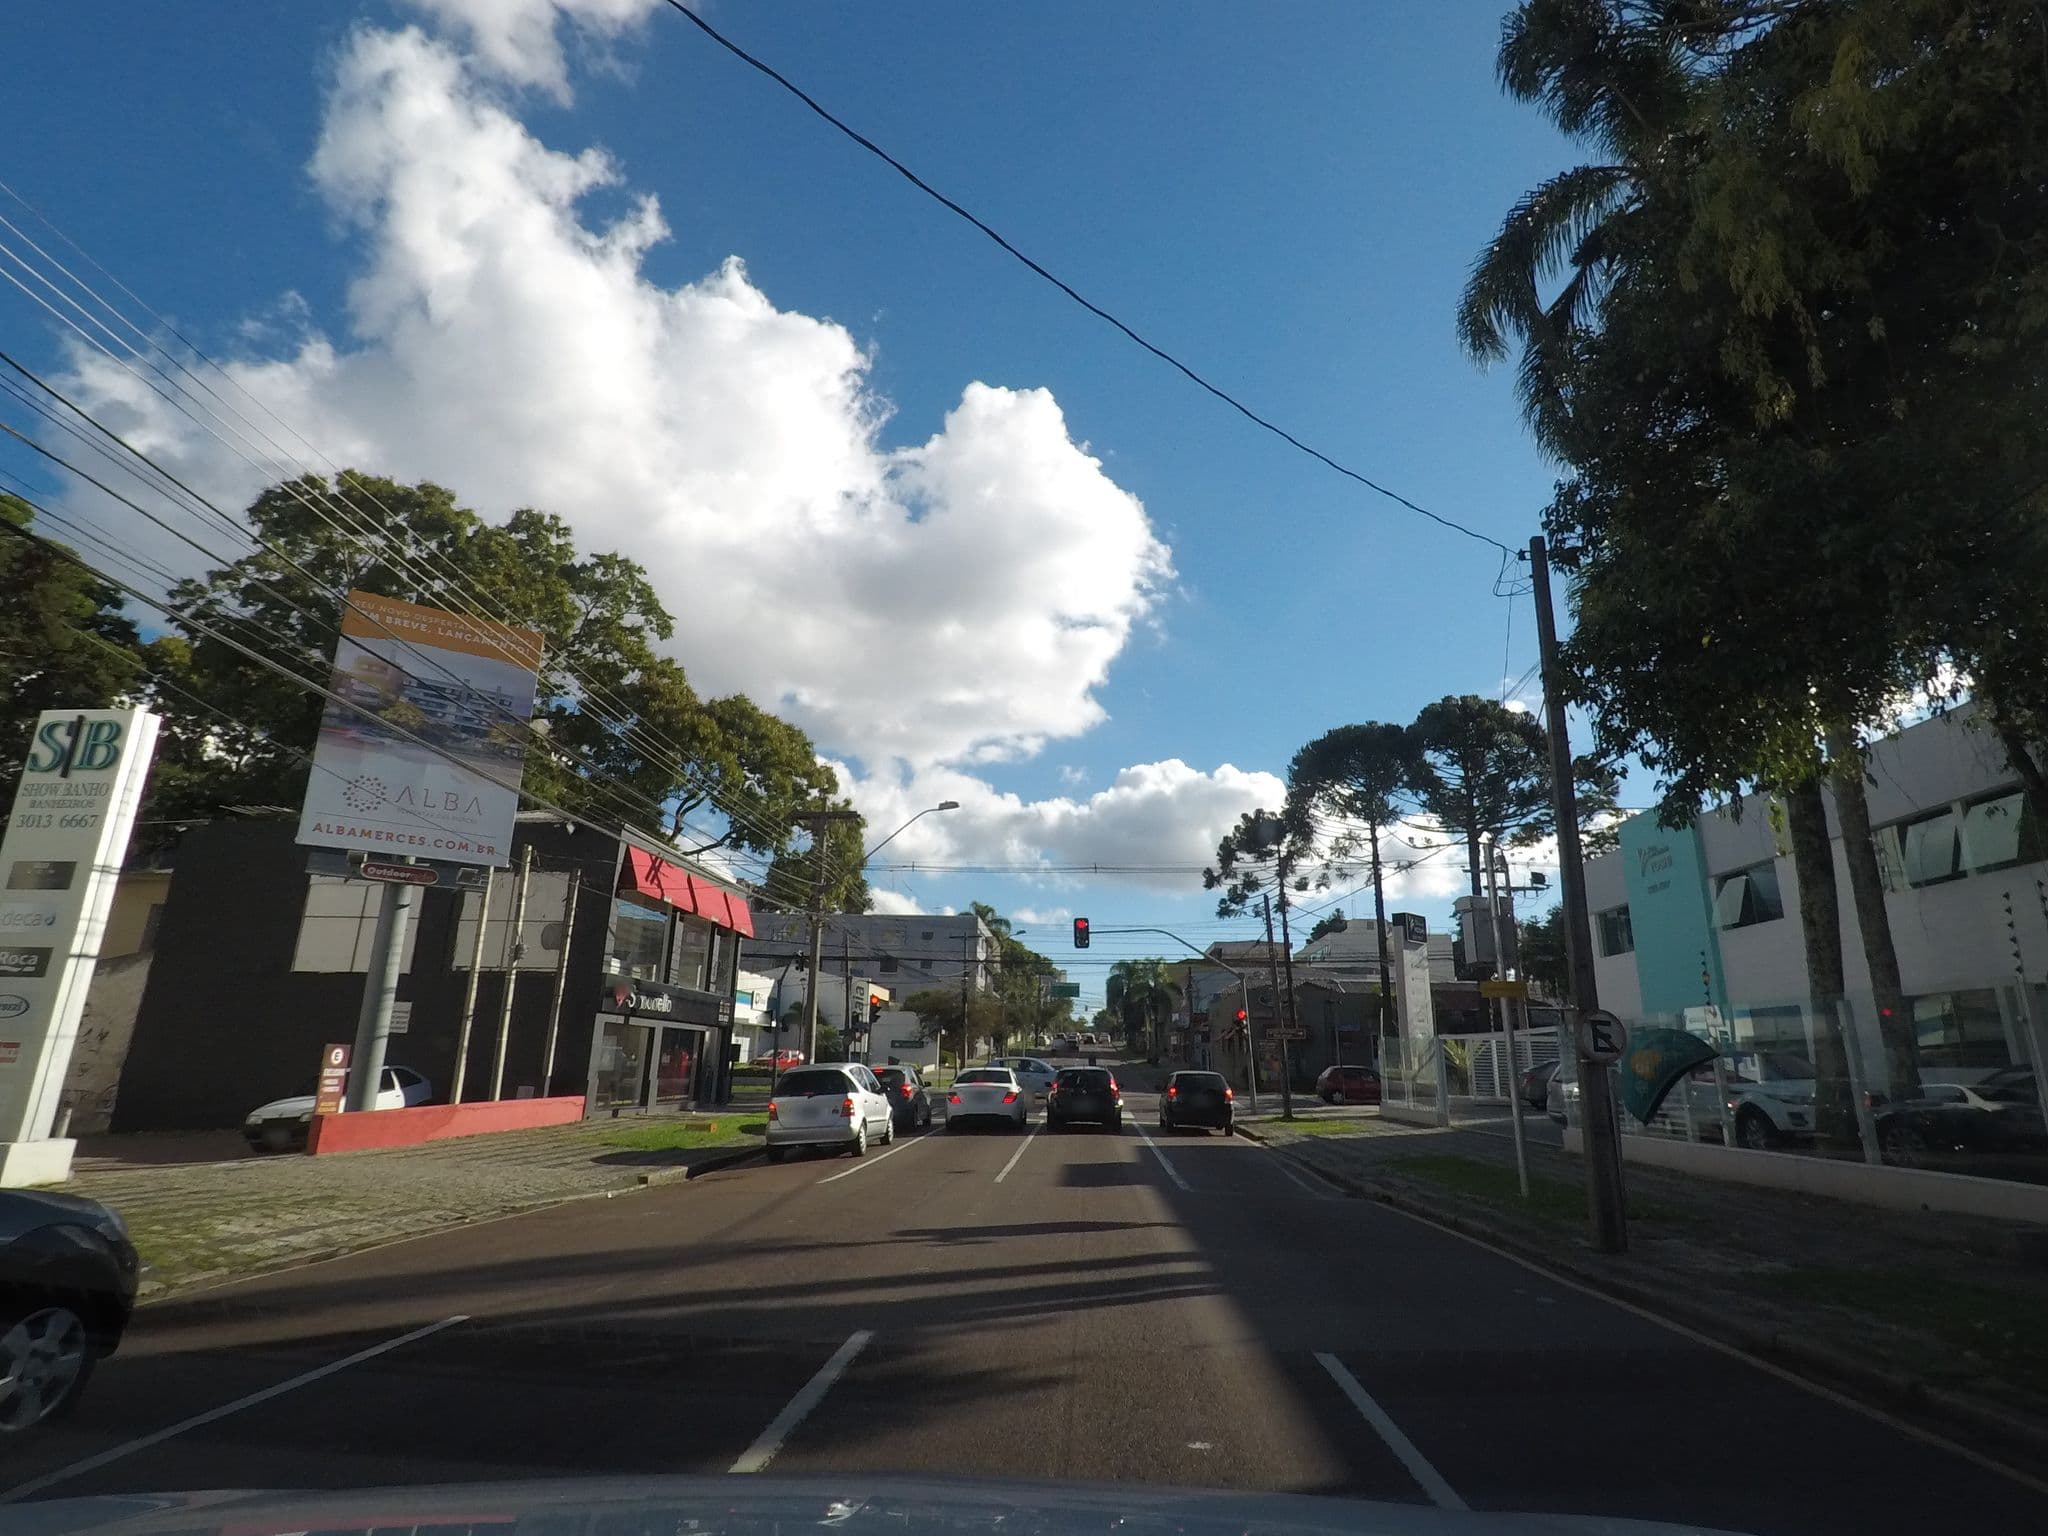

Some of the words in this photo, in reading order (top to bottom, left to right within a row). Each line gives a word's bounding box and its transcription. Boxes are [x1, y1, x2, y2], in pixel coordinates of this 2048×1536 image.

[385, 615, 431, 633] BREVE,
[22, 783, 60, 797] SHOW
[60, 783, 110, 797] BANHO
[395, 784, 483, 816] ALBA
[16, 814, 52, 828] 3013
[59, 814, 99, 828] 6667
[312, 822, 497, 856] ALBAMERCES.COM.BR
